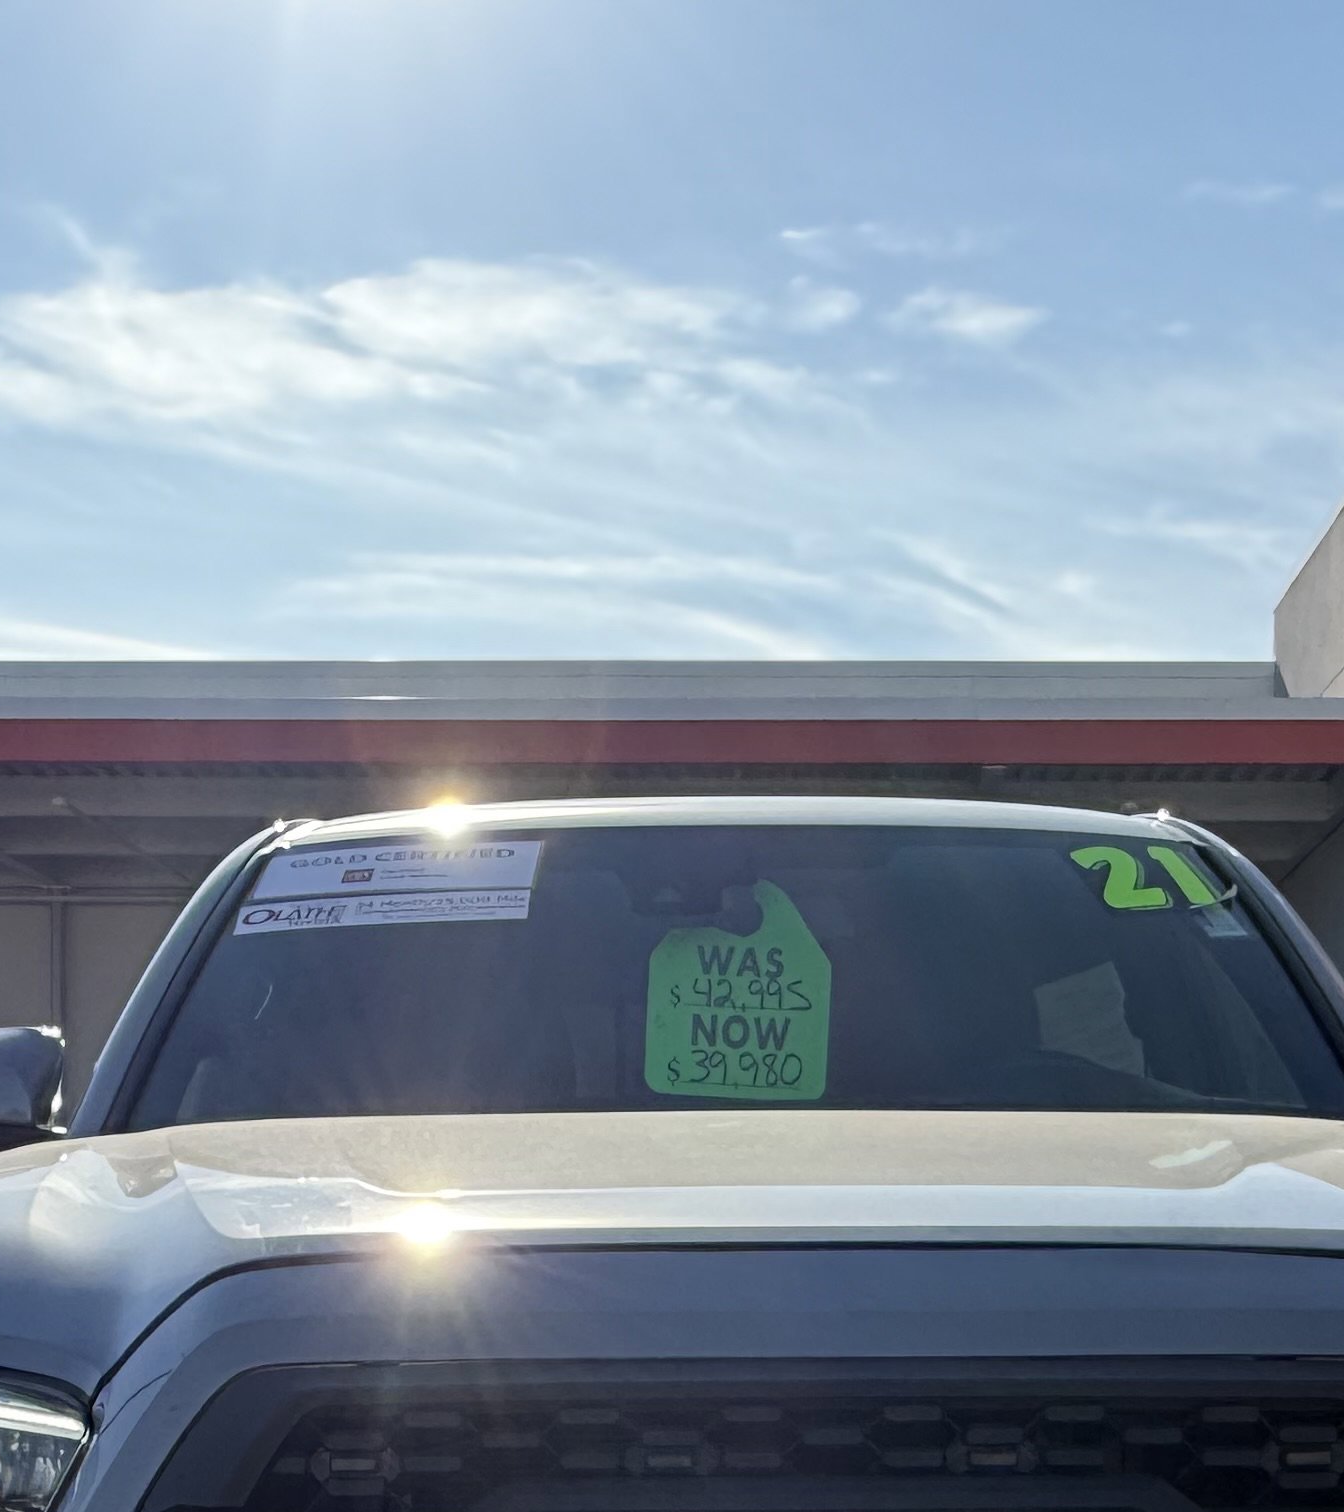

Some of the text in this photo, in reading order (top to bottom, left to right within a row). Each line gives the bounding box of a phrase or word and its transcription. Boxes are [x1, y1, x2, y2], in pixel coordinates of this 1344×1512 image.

[1069, 846, 1238, 909] 21
[697, 944, 785, 979] WAS
[691, 1013, 791, 1050] NOW
